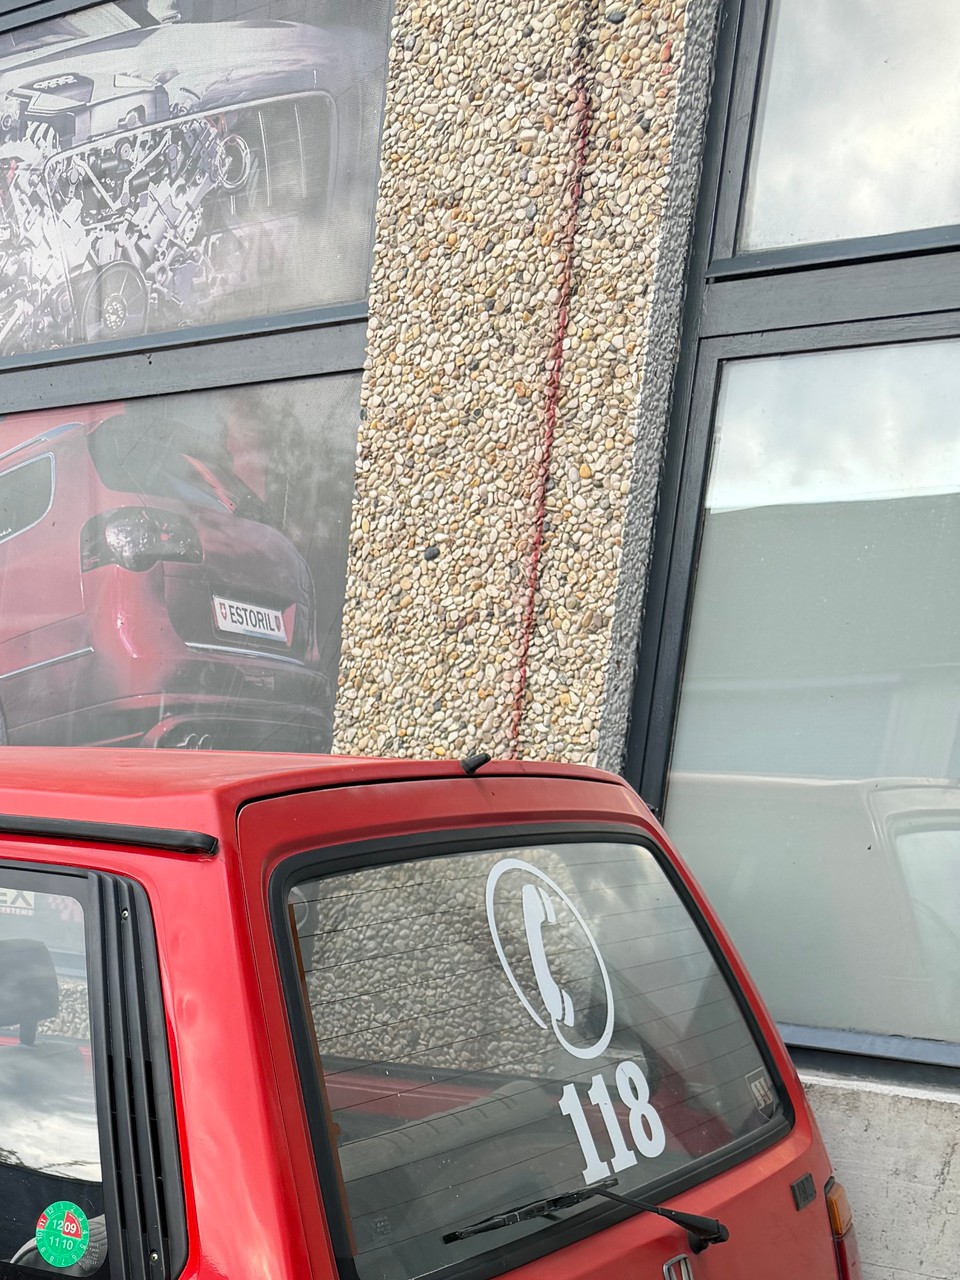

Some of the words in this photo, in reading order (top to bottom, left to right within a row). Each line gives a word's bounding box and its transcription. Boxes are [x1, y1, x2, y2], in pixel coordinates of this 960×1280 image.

[228, 604, 276, 632] ESTORIL
[559, 1061, 666, 1185] 118
[52, 1219, 64, 1230] 12
[64, 1222, 77, 1234] 09
[49, 1236, 60, 1247] 11
[62, 1238, 74, 1251] 10
